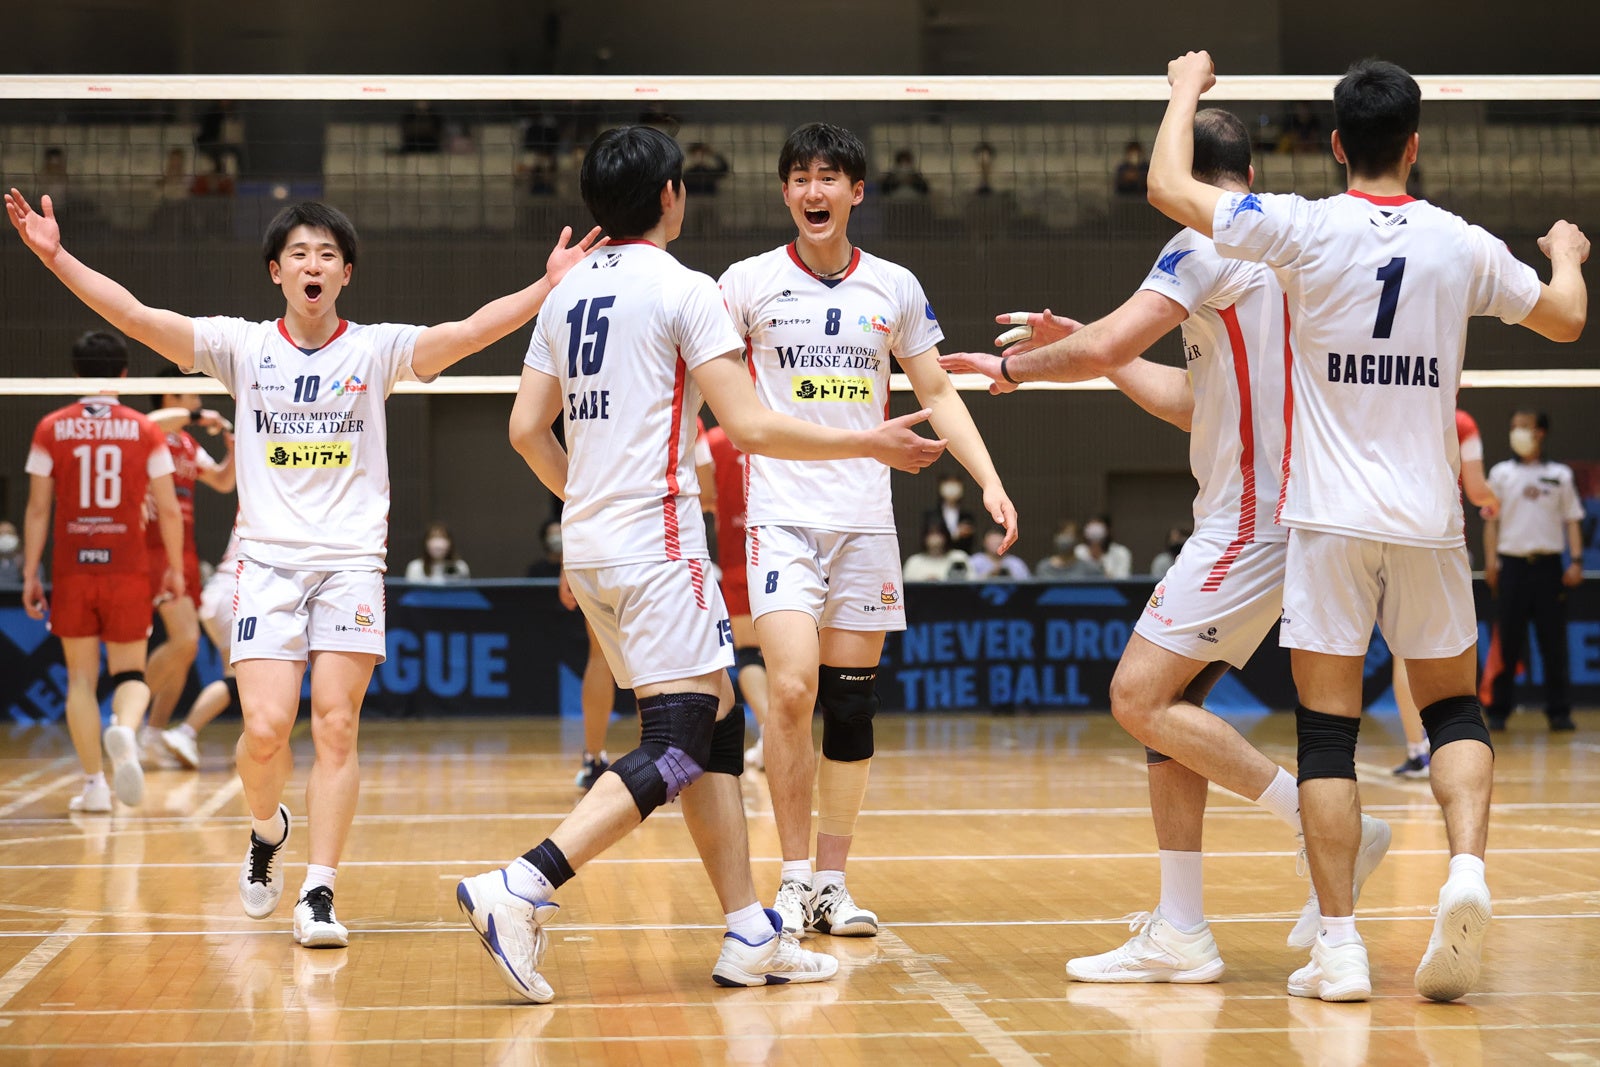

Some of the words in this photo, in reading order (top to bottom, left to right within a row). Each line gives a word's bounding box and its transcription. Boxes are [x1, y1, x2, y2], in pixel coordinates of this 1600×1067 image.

[1371, 257, 1406, 339] 1
[824, 308, 841, 335] 8
[566, 295, 616, 378] 15
[774, 345, 841, 369] WEISSE
[807, 345, 832, 354] OITA
[835, 346, 877, 357] MIYOSHI
[1328, 352, 1439, 388] BAGUNAS
[293, 375, 320, 403] 10
[820, 385, 870, 400] トリアナ
[280, 412, 306, 421] OITA
[309, 411, 353, 421] MIYOSHI
[568, 390, 609, 421] SABE
[54, 417, 140, 441] HASEYAMA
[253, 409, 314, 434] WEISSE
[317, 420, 364, 434] ADLER
[293, 451, 347, 465] トリアナ
[73, 444, 122, 509] 18
[765, 570, 779, 594] 8
[237, 616, 257, 642] 10
[716, 618, 735, 647] 15
[903, 619, 1034, 664] NEVER
[1045, 619, 1134, 661] DRO
[897, 666, 984, 711] THE
[989, 665, 1090, 706] BALL
